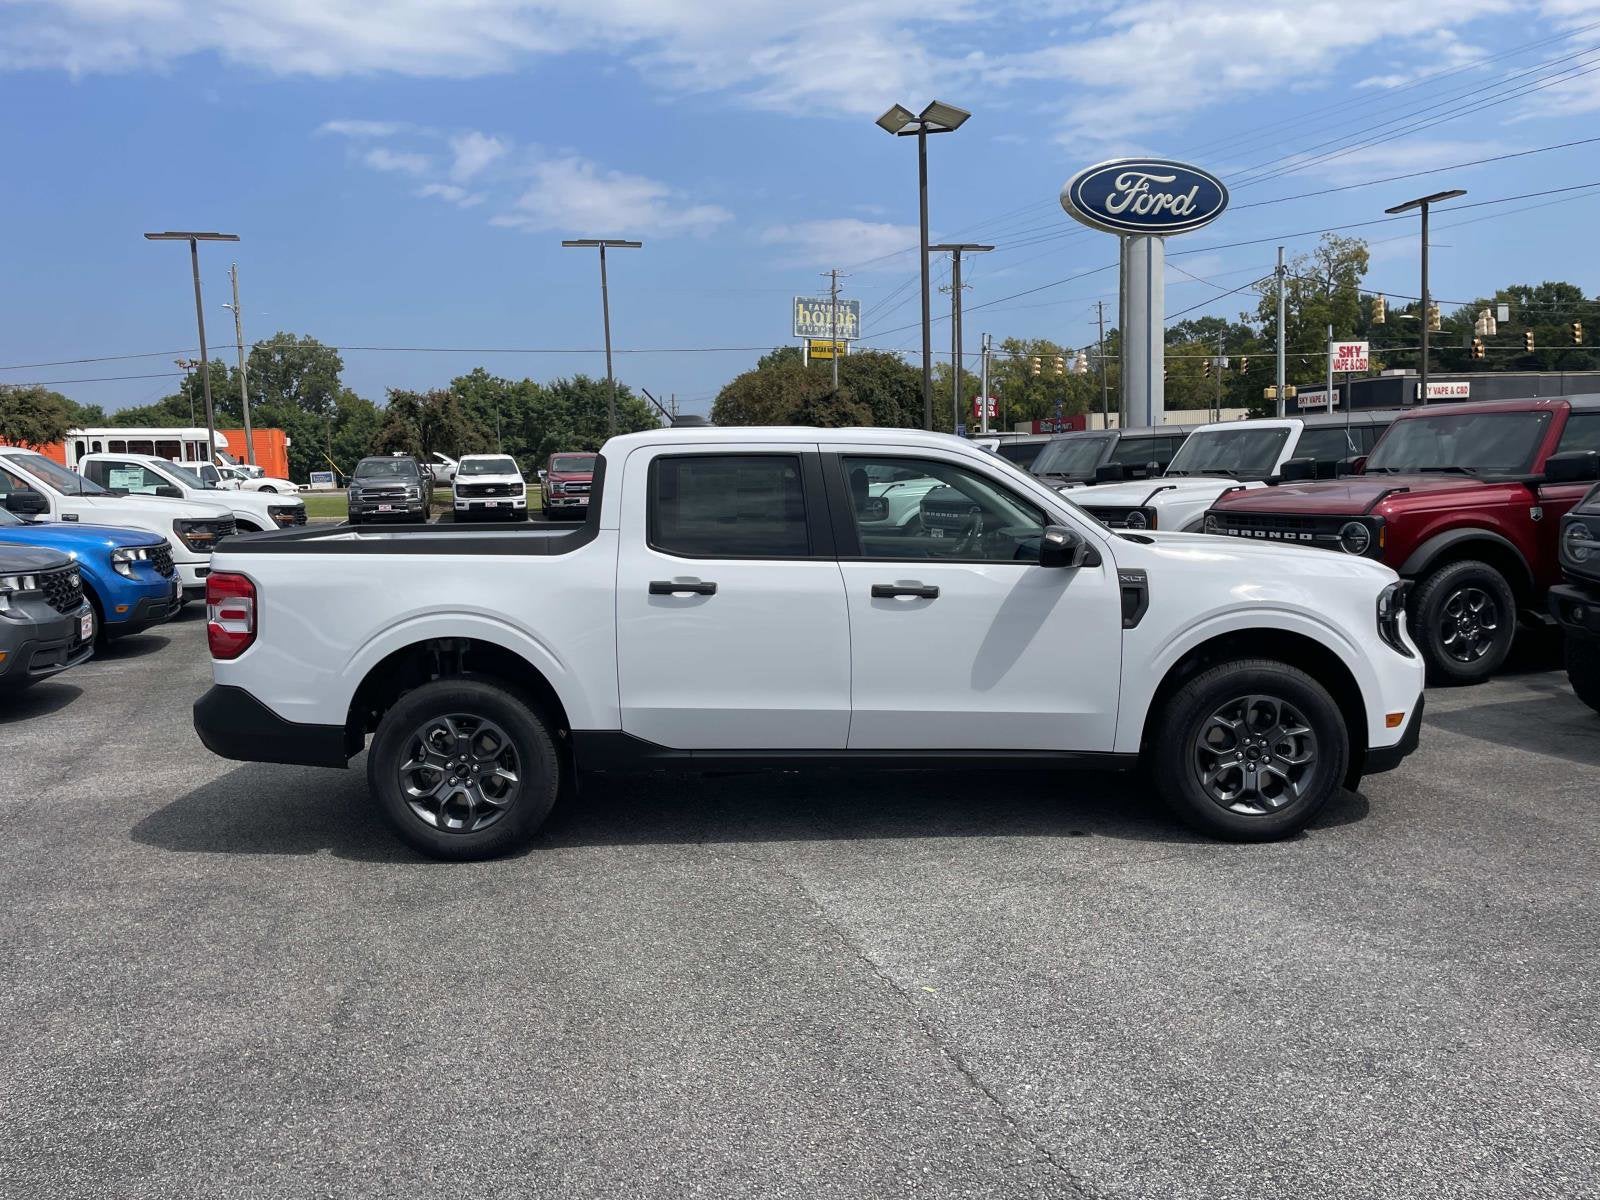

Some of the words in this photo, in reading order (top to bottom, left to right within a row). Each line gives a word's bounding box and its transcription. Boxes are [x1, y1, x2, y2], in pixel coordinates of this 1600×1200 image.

[1105, 171, 1199, 216] Ford
[1338, 345, 1362, 358] SKY
[1333, 358, 1349, 370] VAPE
[1350, 358, 1355, 370] &
[1355, 358, 1367, 370] CBD
[1433, 386, 1449, 395] VAPE
[1456, 385, 1468, 394] CBD
[1298, 396, 1308, 405] SKY
[1228, 528, 1313, 540] BRONCO
